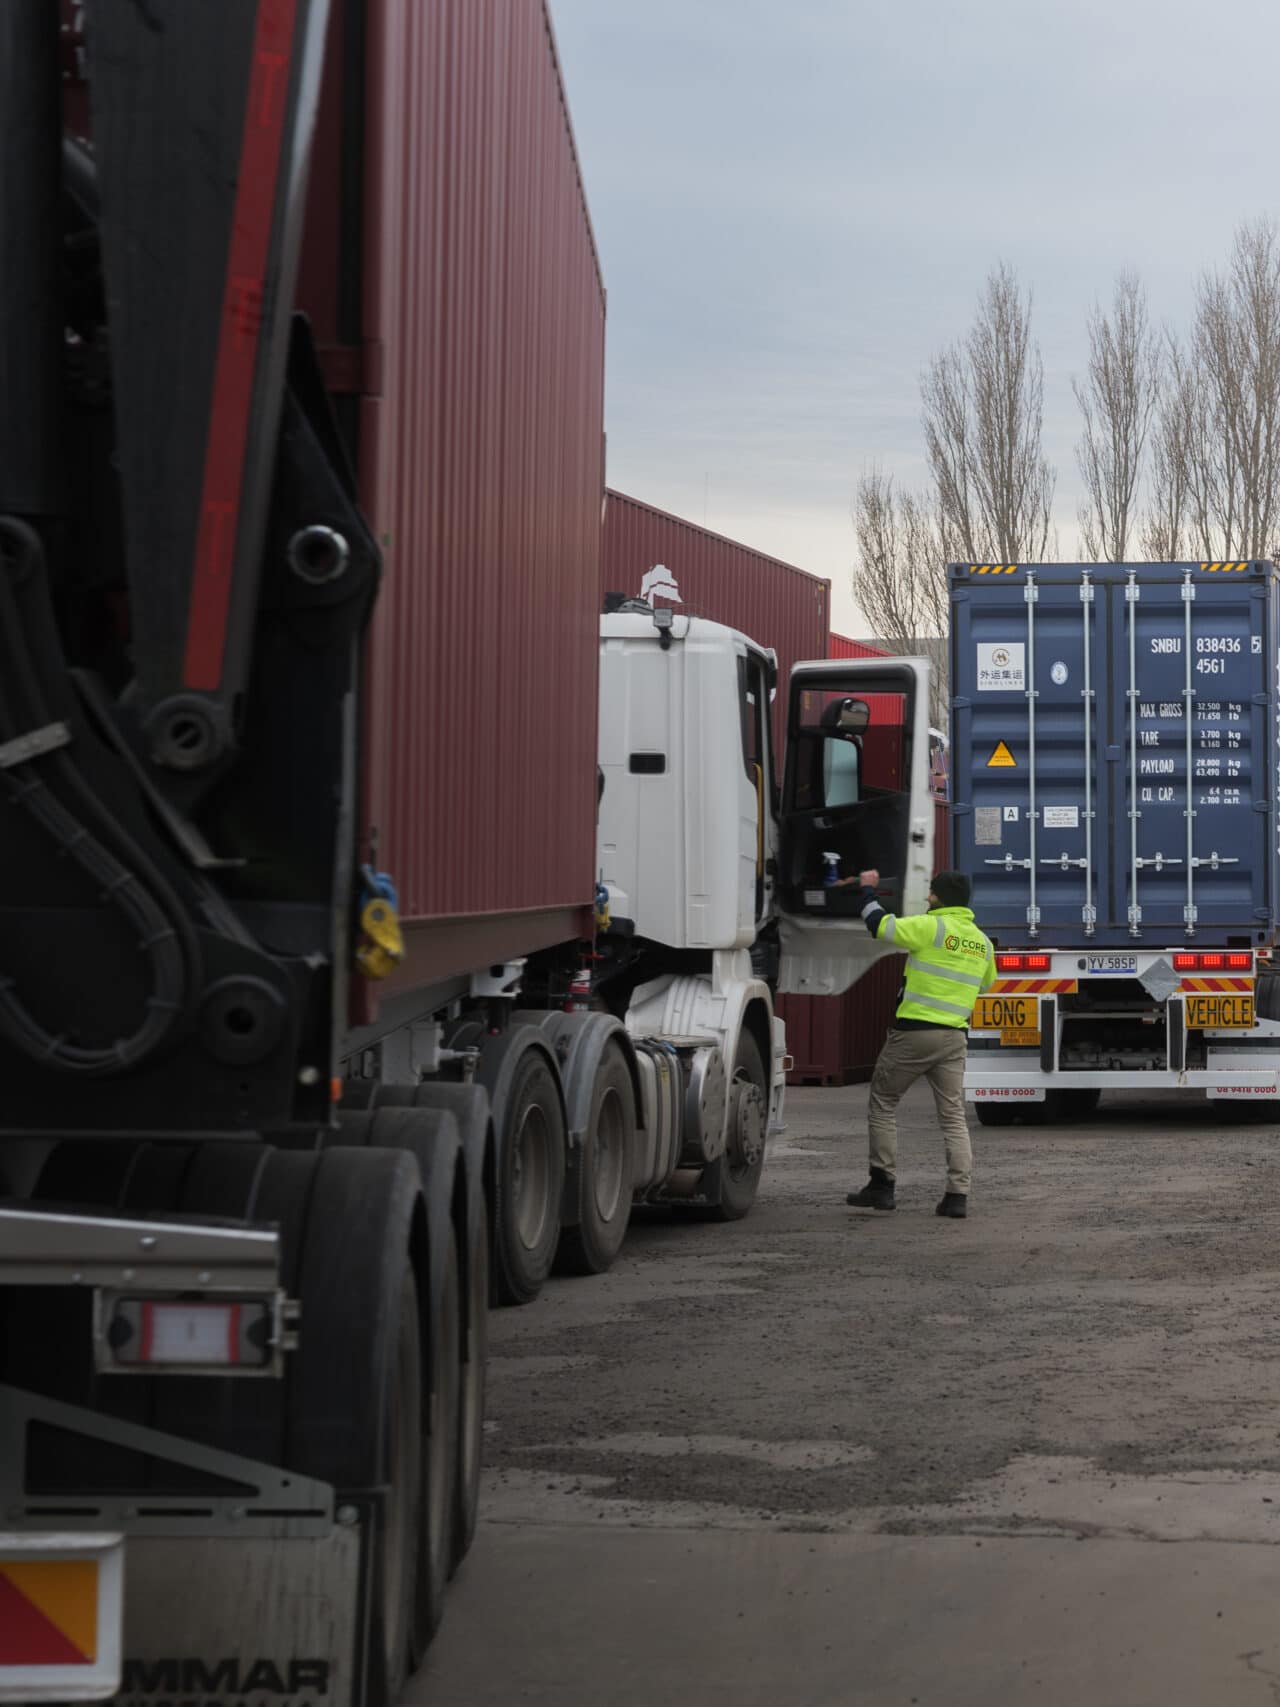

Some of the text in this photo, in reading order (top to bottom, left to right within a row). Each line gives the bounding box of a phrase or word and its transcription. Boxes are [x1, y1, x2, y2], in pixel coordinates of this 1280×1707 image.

[1151, 636, 1262, 653] SNBU 838436 5
[1196, 659, 1225, 673] 45G1
[1140, 703, 1156, 718] MAX
[1160, 703, 1183, 718] GROSS
[1228, 703, 1242, 712] kg
[1228, 712, 1240, 720] lb
[1140, 731, 1160, 746] TARE
[1228, 731, 1241, 740] kg
[1228, 740, 1240, 748] lb
[1140, 759, 1175, 774] PAYLOAD
[1228, 759, 1241, 769] kg
[1227, 768, 1239, 776] lb
[1007, 808, 1016, 819] A
[961, 939, 986, 953] CORE
[982, 1000, 1026, 1026] LONG
[1186, 998, 1250, 1026] VEHICLE
[1012, 1089, 1036, 1097] 0000
